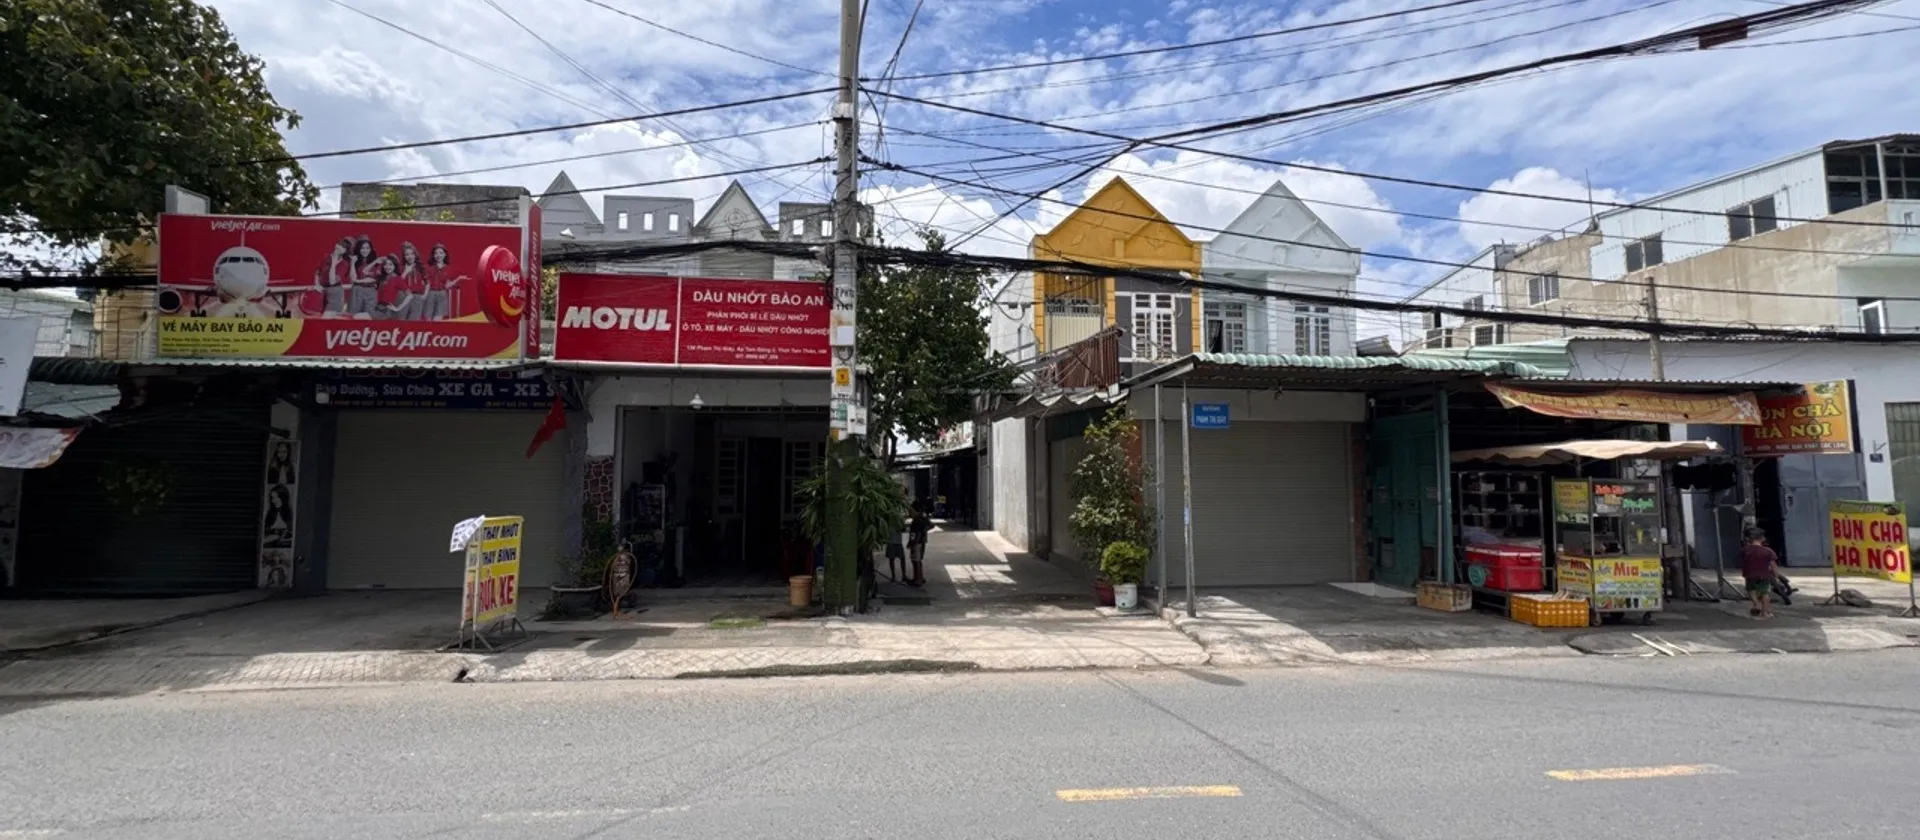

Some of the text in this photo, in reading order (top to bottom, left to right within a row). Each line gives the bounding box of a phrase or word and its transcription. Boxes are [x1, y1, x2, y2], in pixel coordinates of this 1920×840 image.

[727, 291, 768, 304] NHỚT
[804, 295, 824, 306] AN
[211, 322, 234, 333] BAY
[238, 319, 262, 333] BẢO
[266, 322, 283, 333] AN
[561, 306, 672, 331] MOTUL
[437, 382, 465, 396] XE
[470, 382, 495, 397] GA
[514, 383, 541, 397] XE
[1793, 398, 1841, 419] CHẢ
[1754, 418, 1832, 440] HÀ NỘI
[499, 575, 515, 607] XE
